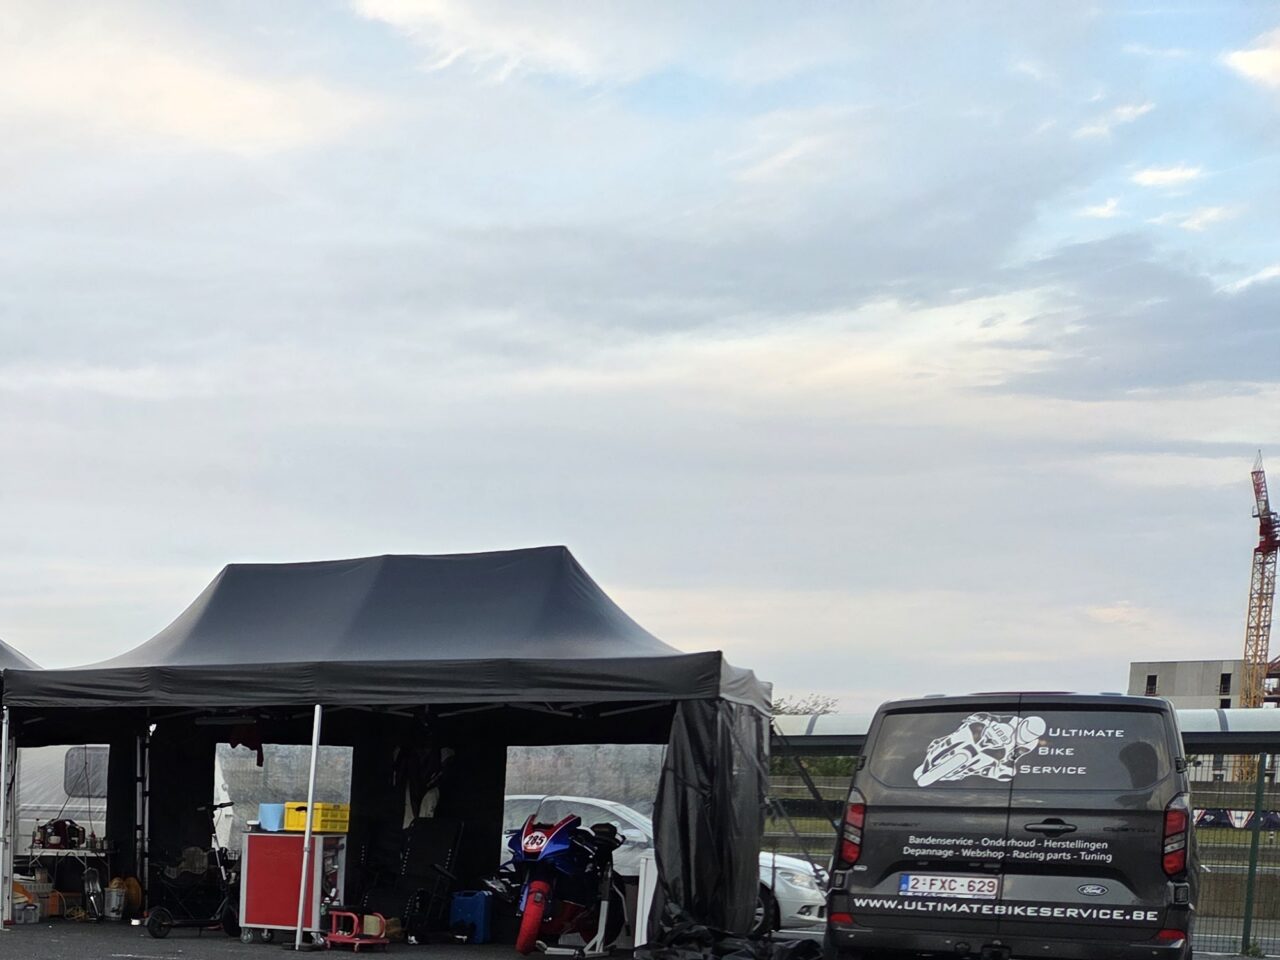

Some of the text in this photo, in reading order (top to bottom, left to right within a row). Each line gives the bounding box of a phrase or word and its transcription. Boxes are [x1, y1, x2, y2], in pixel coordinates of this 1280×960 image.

[1048, 727, 1125, 738] ULTIMATE
[1038, 747, 1075, 756] BIKE
[1020, 765, 1087, 775] SERVICE
[908, 835, 973, 846] Bandenservice
[981, 837, 1036, 848] Onderhoud
[1044, 839, 1108, 850] Herstellingen
[903, 846, 954, 857] Depannage
[961, 848, 1005, 859] Webshop
[1012, 850, 1045, 861] Racing
[1046, 851, 1071, 861] parts
[1080, 852, 1113, 863] Tuning
[1081, 885, 1106, 895] Ford
[853, 898, 1159, 921] WWW.ULTIMATEBIKESERVICE.BE
